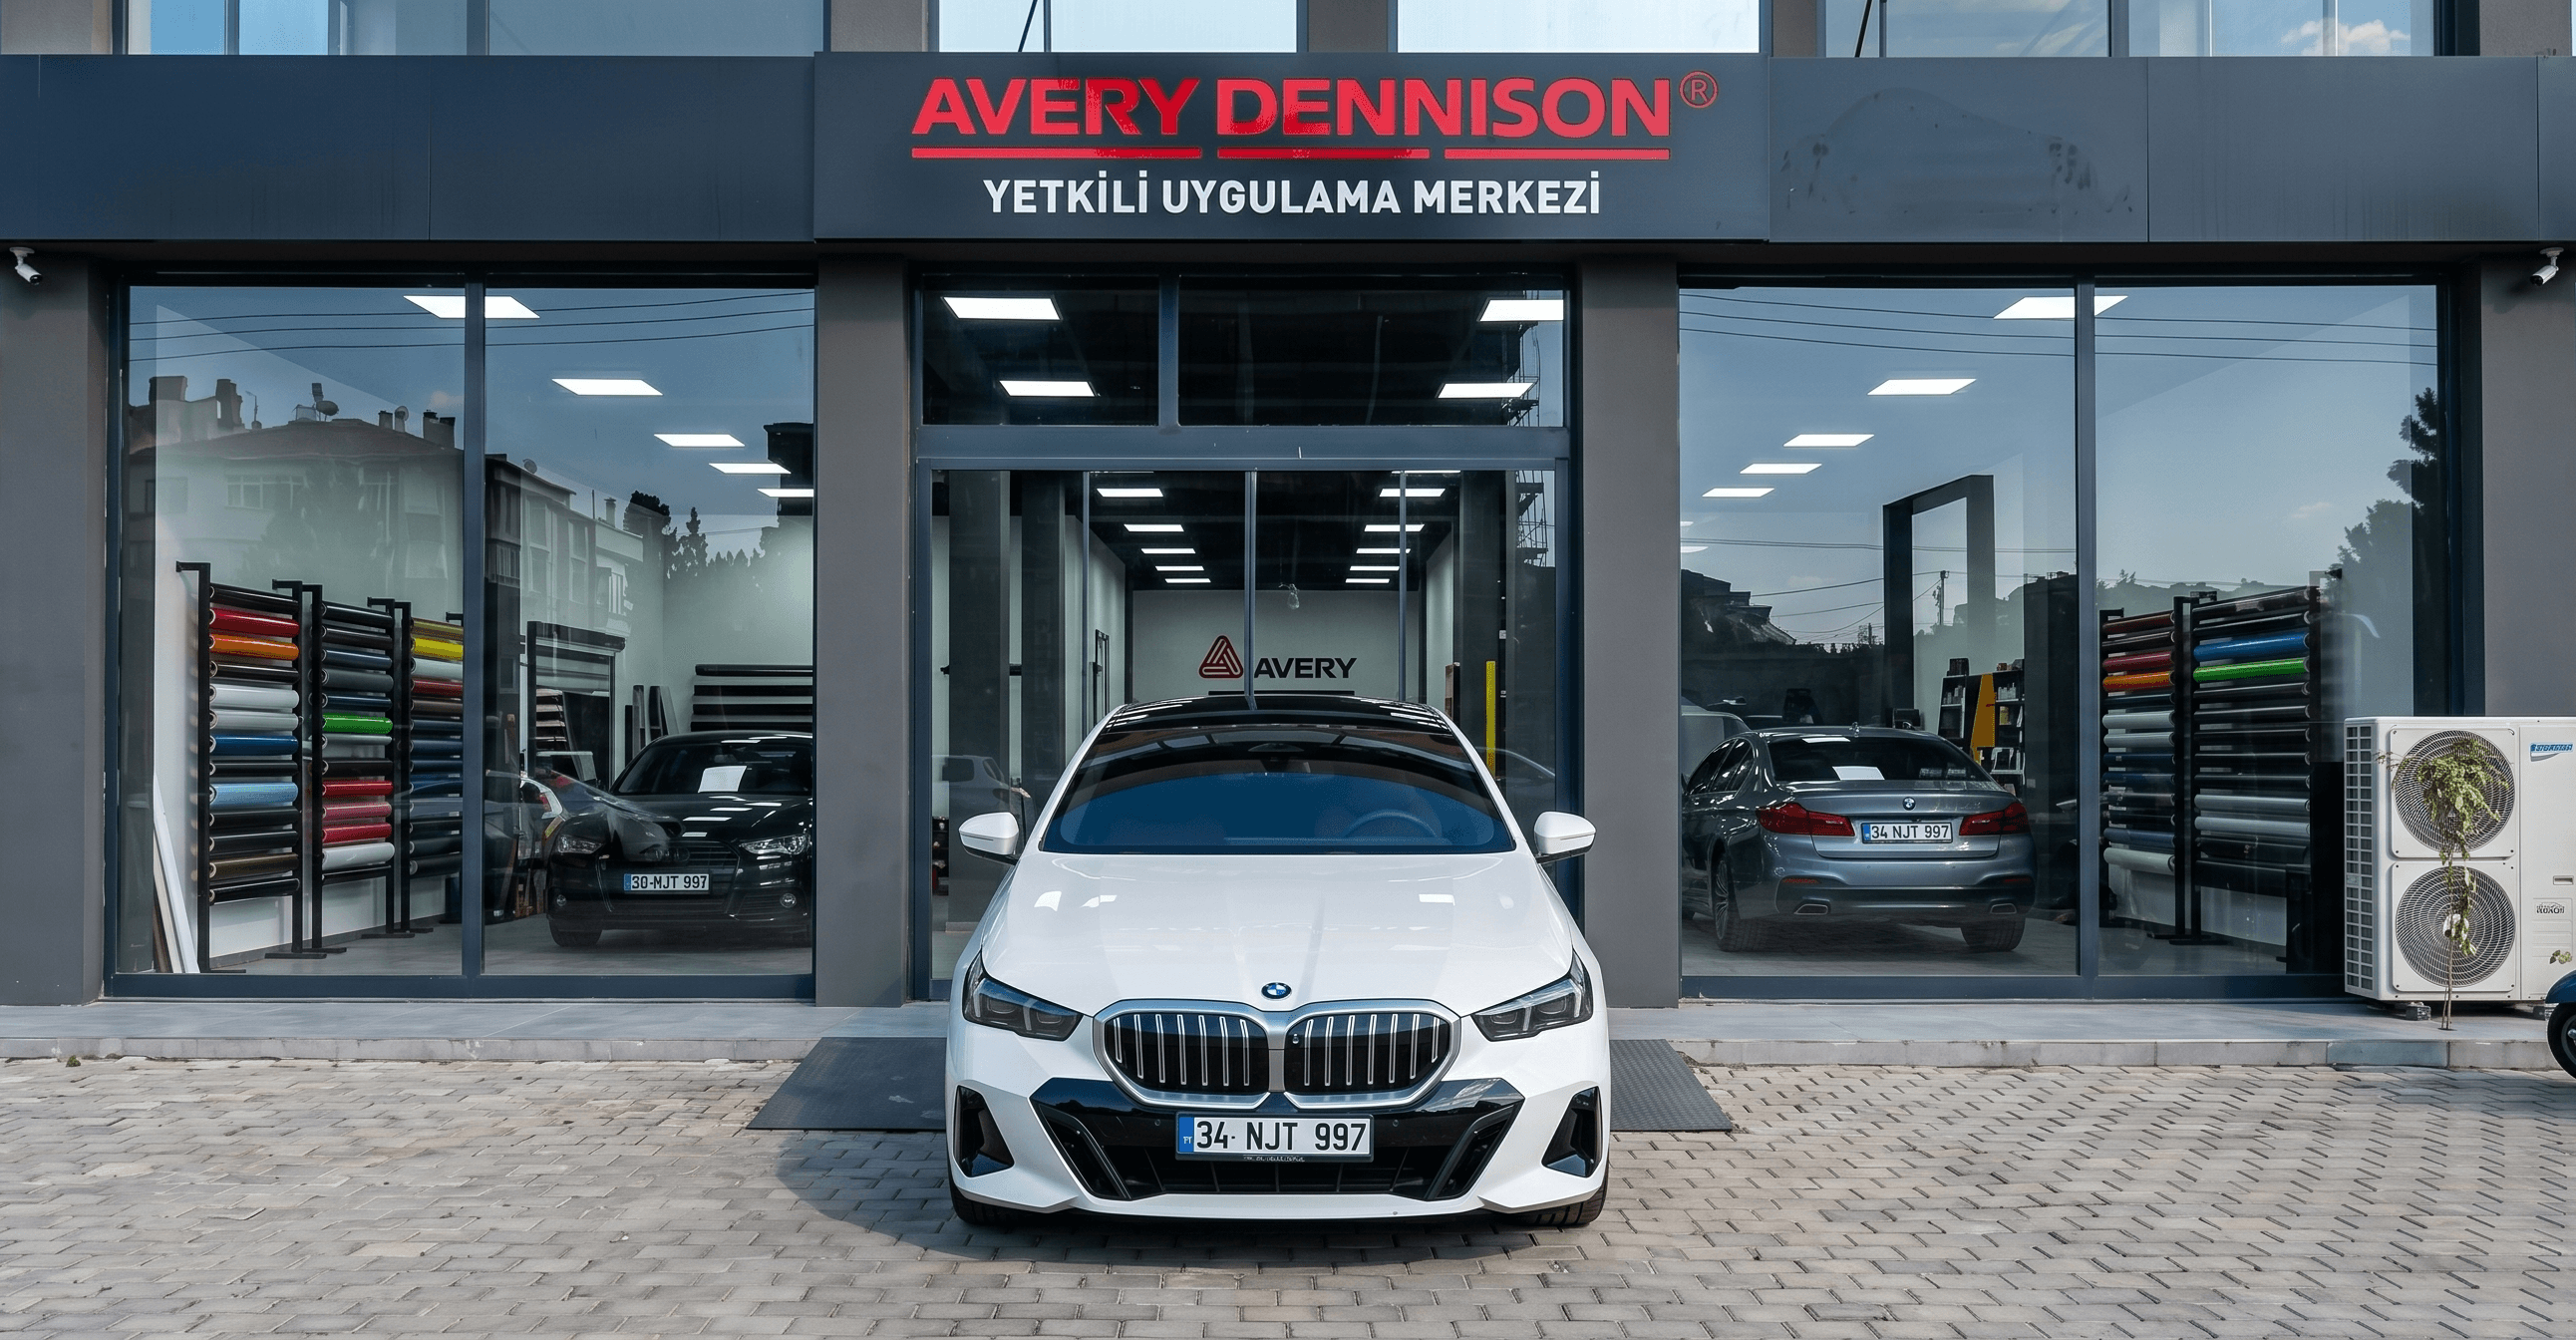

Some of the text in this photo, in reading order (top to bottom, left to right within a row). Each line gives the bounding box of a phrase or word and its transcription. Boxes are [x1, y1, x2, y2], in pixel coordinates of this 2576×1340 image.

[911, 77, 1200, 137] AVERY
[983, 169, 1600, 214] YETKİLİ UYGULAMA MERKEZİ
[1253, 657, 1358, 679] AVERY
[1871, 825, 1949, 839] 34 NJT 997
[683, 875, 707, 889] 997
[1246, 1122, 1300, 1151] NJT
[1314, 1122, 1368, 1152] 997
